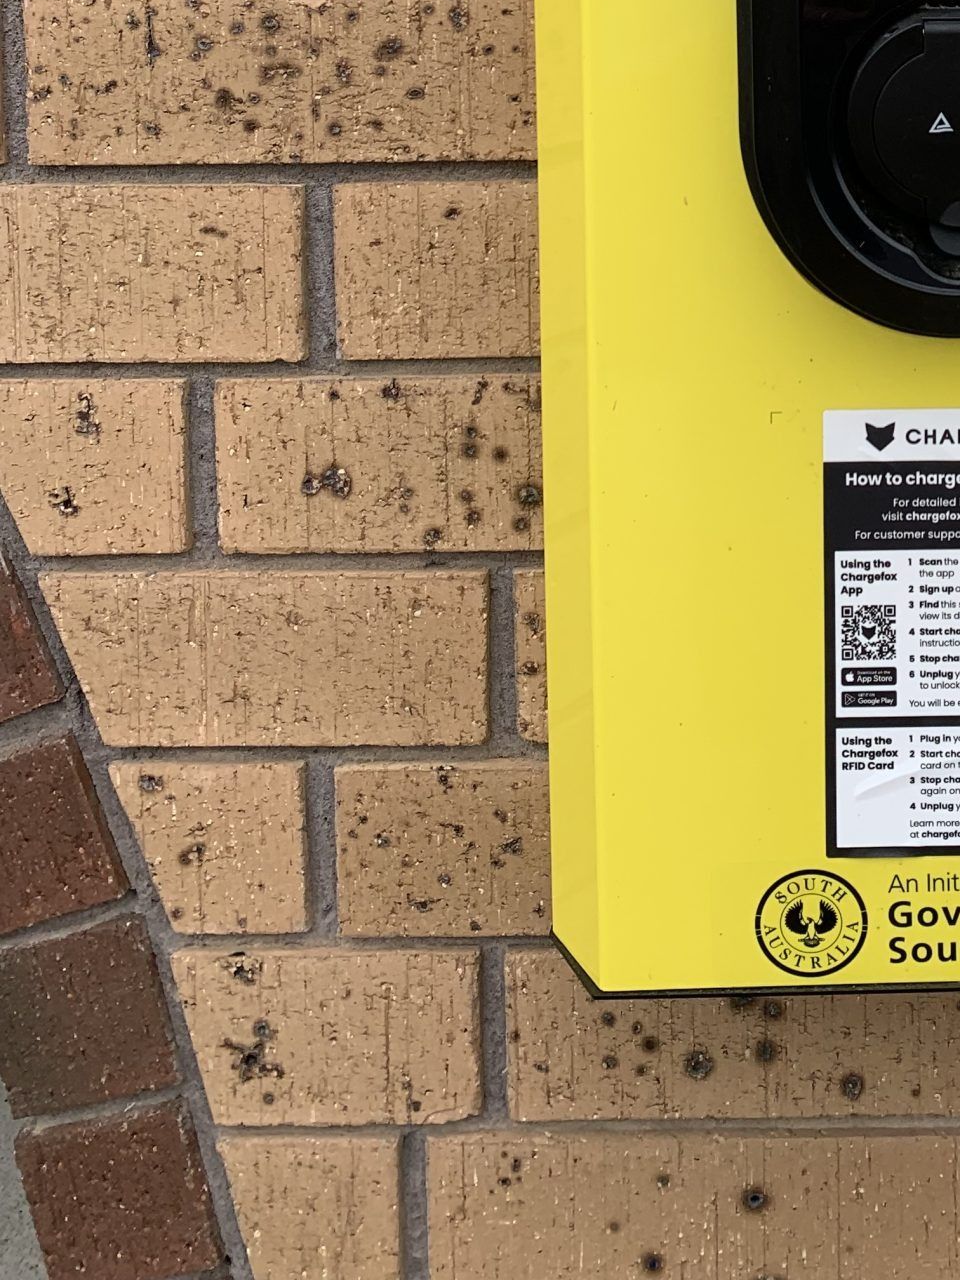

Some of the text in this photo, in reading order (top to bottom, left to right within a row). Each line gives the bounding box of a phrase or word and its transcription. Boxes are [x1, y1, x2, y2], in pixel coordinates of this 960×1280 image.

[846, 472, 882, 486] How
[886, 473, 902, 486] to
[893, 498, 909, 507] For
[912, 498, 956, 507] detailed
[882, 511, 903, 521] visit
[855, 530, 871, 540] For
[874, 530, 925, 540] customer
[840, 559, 891, 570] Using the
[919, 558, 942, 566] Scan
[944, 557, 958, 565] the
[841, 572, 897, 583] Chargefox
[919, 569, 954, 580] the app
[841, 585, 863, 596] App
[919, 584, 939, 594] Sign
[942, 586, 954, 594] up
[919, 600, 939, 608] Find
[941, 600, 956, 608] this
[919, 612, 939, 620] view
[942, 612, 951, 620] its
[920, 627, 942, 636] Start
[920, 654, 940, 664] Stop
[920, 670, 953, 680] Unplug
[920, 681, 928, 690] to
[931, 680, 959, 689] unlock
[881, 697, 894, 705] Play
[909, 699, 925, 707] You
[928, 699, 941, 707] will
[943, 699, 955, 707] be
[842, 736, 892, 747] Using the
[920, 734, 940, 744] Plug
[942, 734, 951, 742] in
[842, 749, 898, 759] Chargefox
[920, 750, 943, 758] Start
[842, 761, 894, 770] RFID Card
[920, 761, 941, 770] card
[921, 776, 941, 786] Stop
[920, 786, 947, 796] again
[921, 802, 954, 812] Unplug
[910, 819, 933, 828] Learn
[910, 830, 919, 838] at
[888, 874, 918, 893] An
[774, 876, 849, 905] SOUTH
[763, 920, 860, 970] AUSTRALIA
